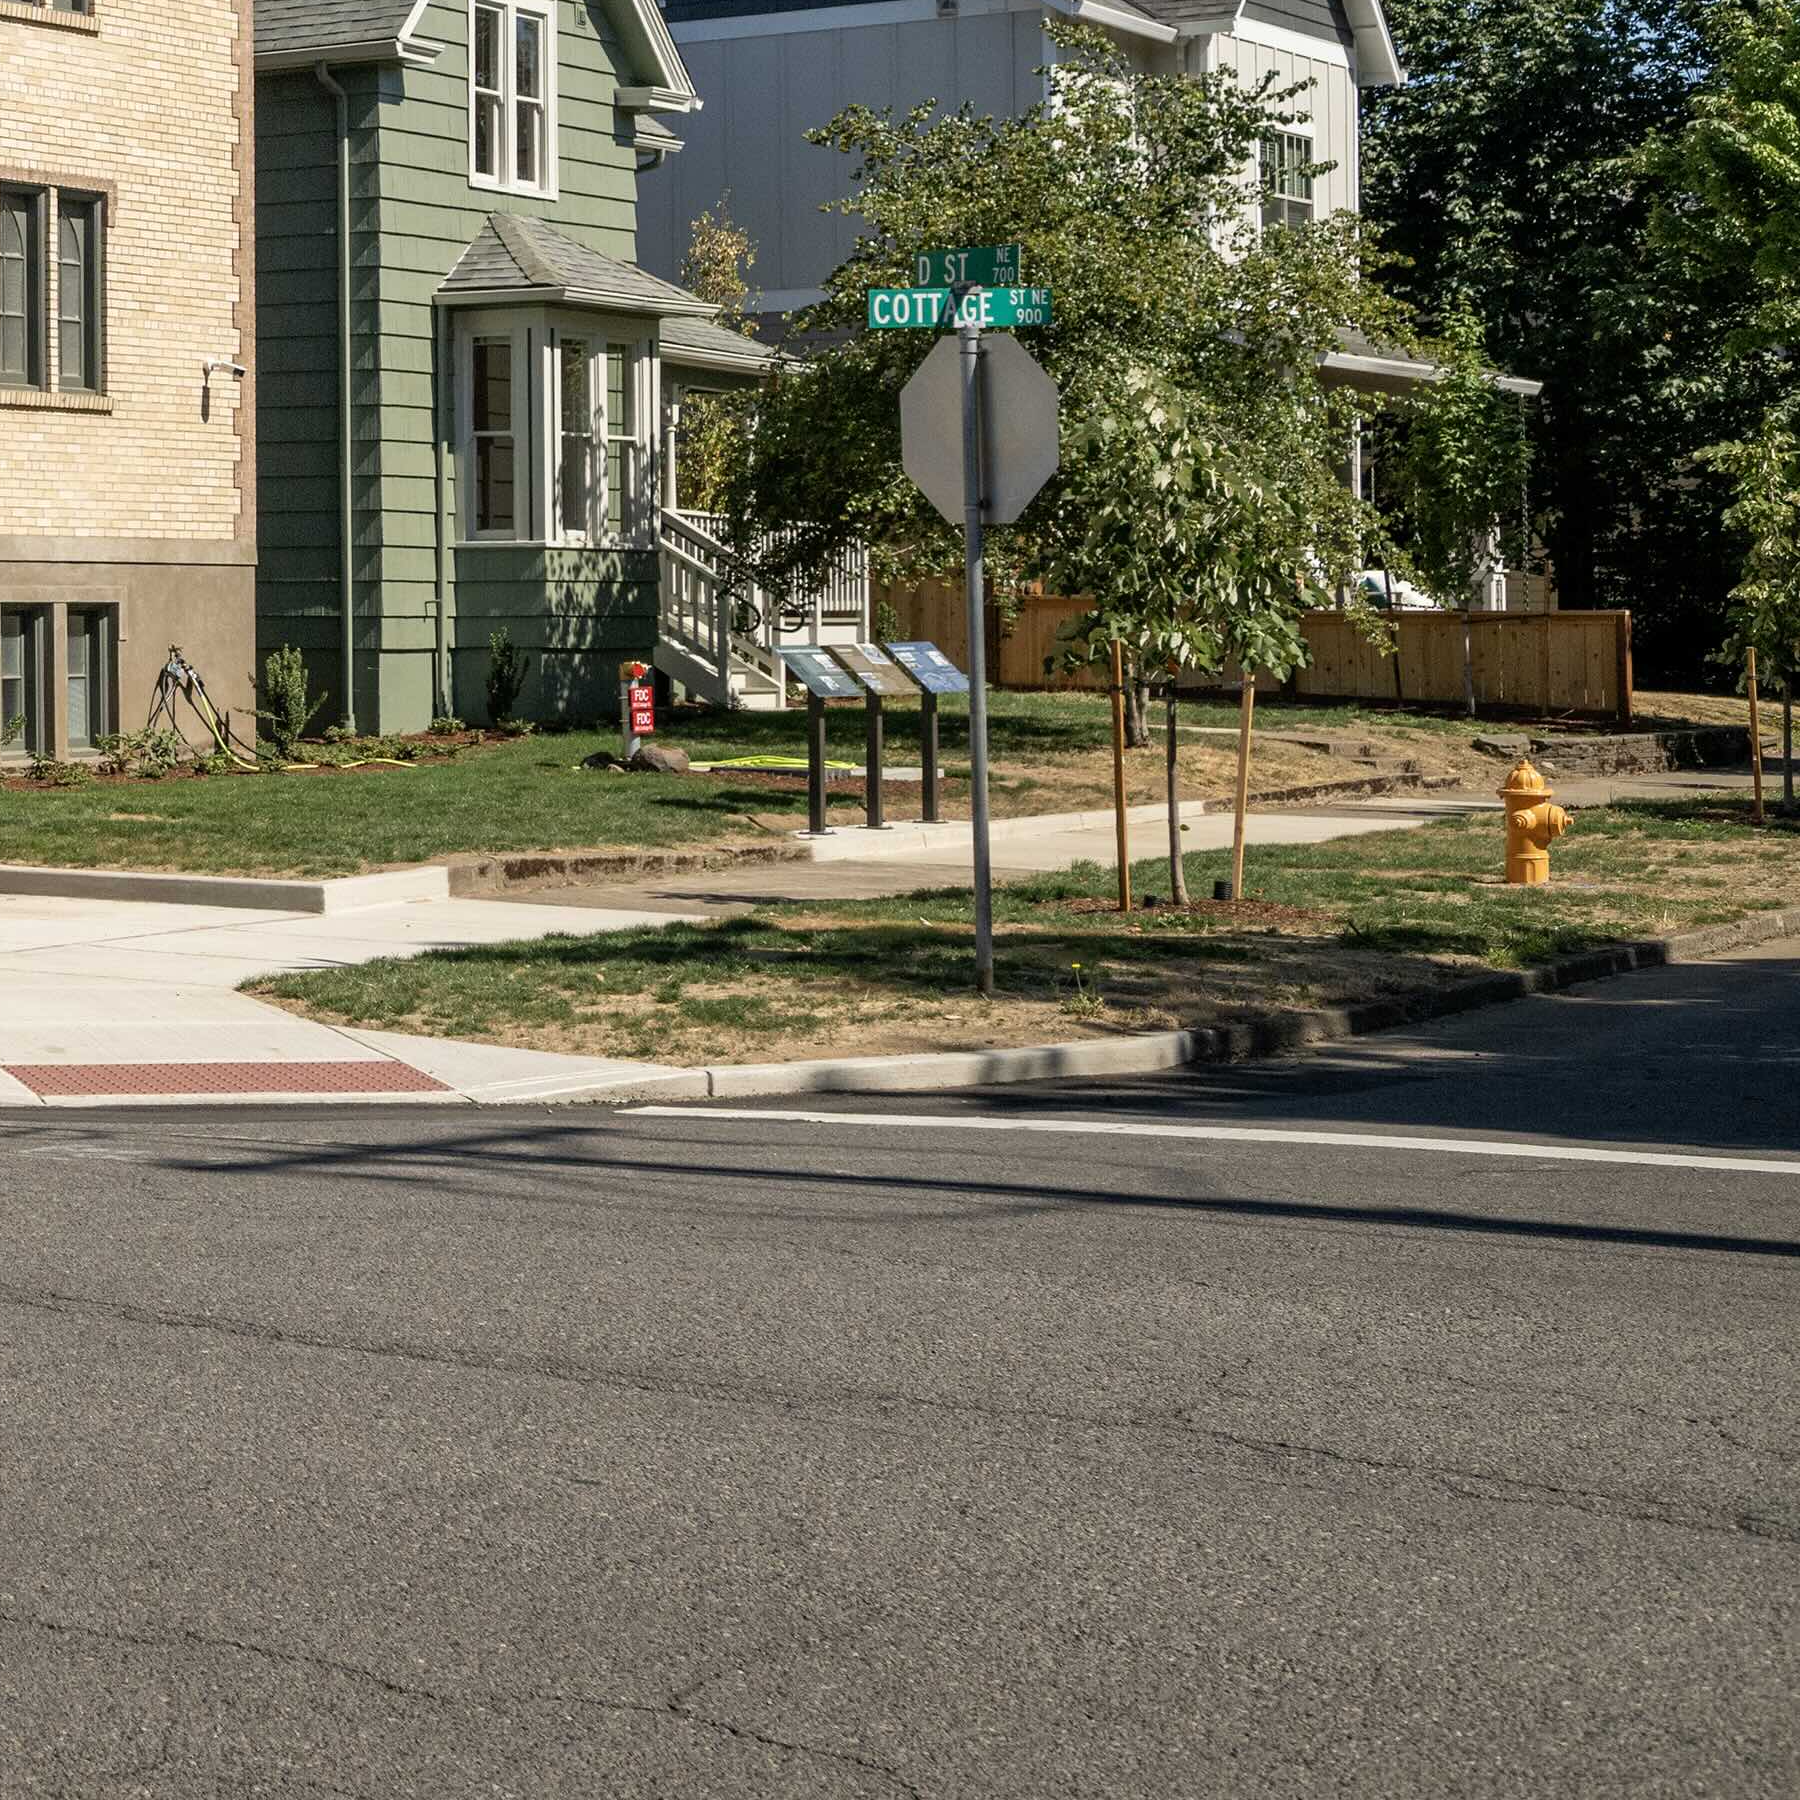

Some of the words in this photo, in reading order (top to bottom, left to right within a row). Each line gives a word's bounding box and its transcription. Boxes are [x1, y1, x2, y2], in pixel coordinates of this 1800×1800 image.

[996, 247, 1011, 263] NE
[919, 256, 930, 286] D
[944, 253, 969, 284] ST
[992, 267, 1015, 283] 700
[1009, 290, 1025, 305] ST
[1032, 290, 1049, 305] NE
[873, 292, 994, 324] COTTAGE
[1016, 309, 1042, 323] 900
